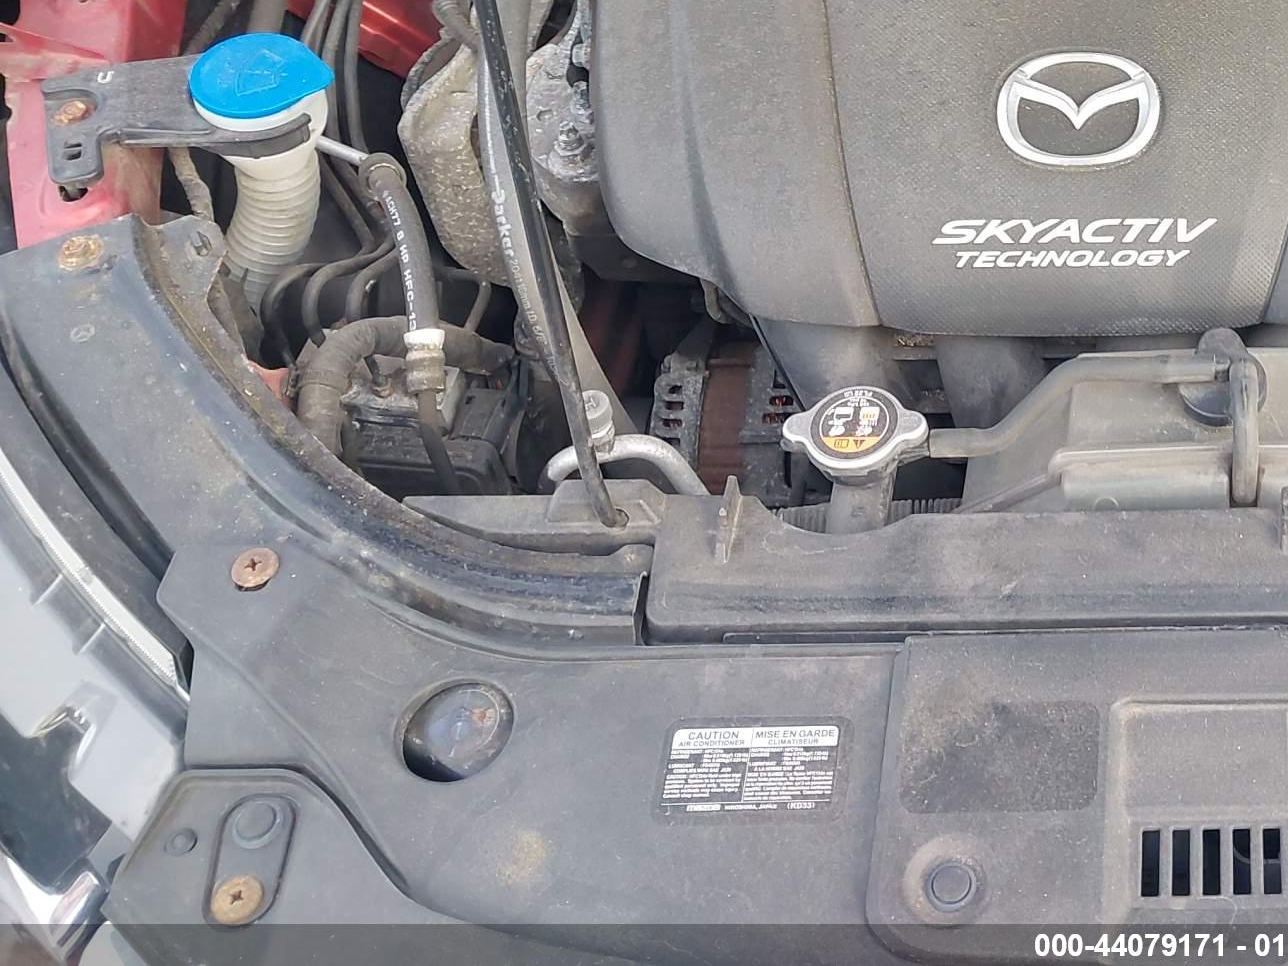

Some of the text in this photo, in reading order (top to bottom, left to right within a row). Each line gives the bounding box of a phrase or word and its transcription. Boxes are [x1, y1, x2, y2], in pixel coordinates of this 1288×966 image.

[932, 218, 1218, 245] SKYACTIV
[955, 250, 1190, 269] TECHNOLOGY
[688, 731, 740, 740] CAUTION
[755, 730, 835, 739] MISE EN GARDE
